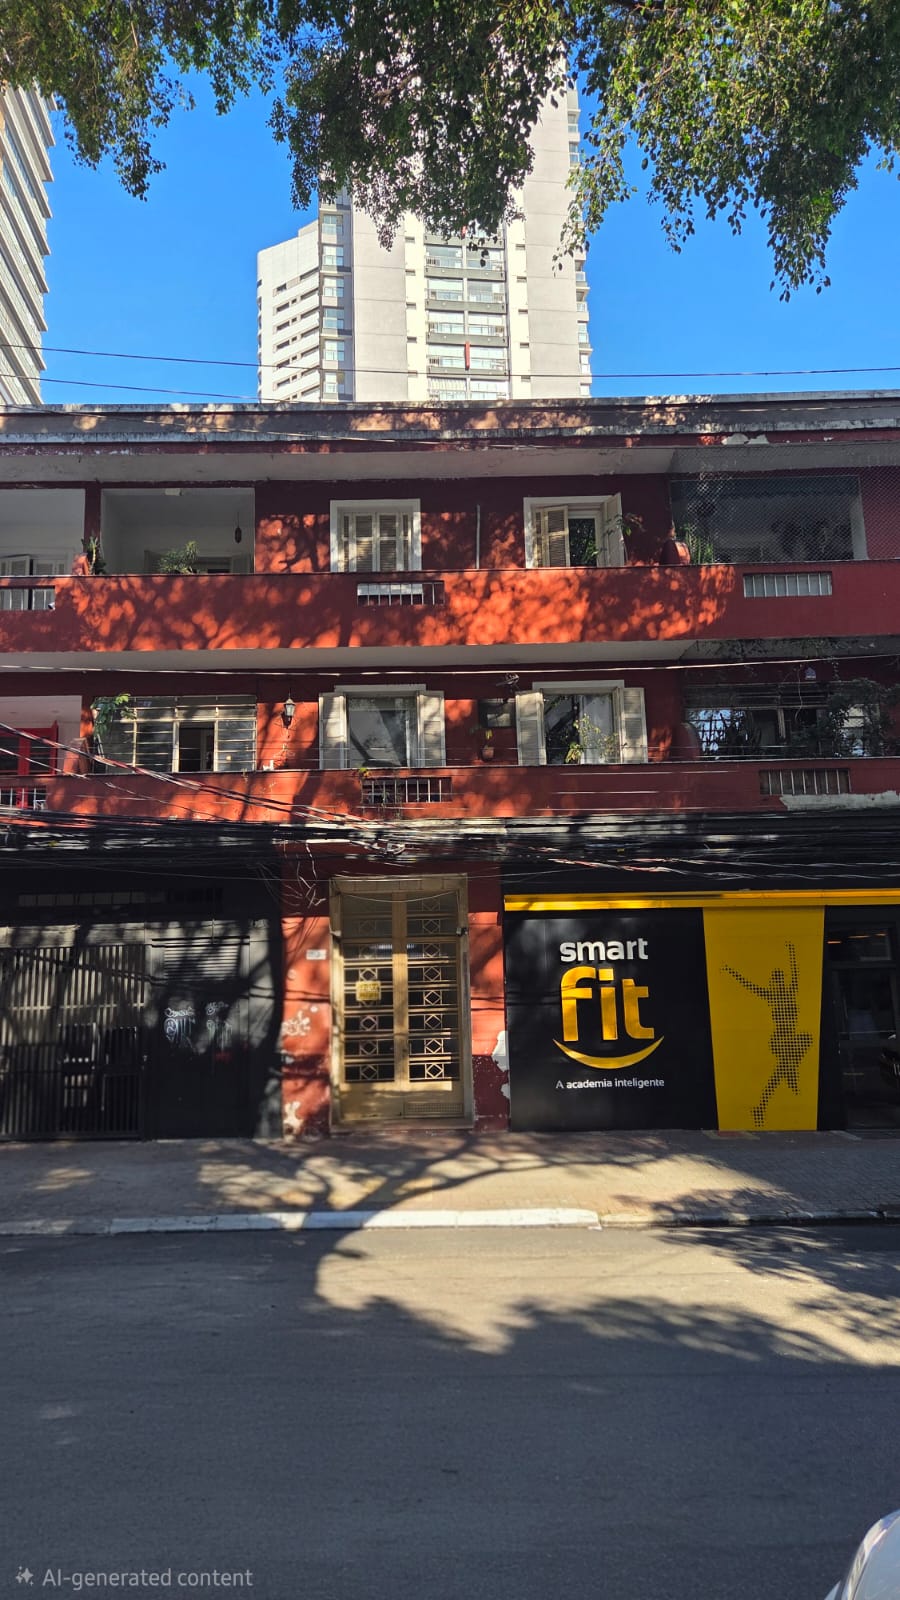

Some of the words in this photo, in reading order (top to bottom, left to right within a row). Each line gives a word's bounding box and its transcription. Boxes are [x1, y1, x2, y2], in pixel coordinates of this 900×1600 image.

[559, 937, 649, 962] smart
[560, 966, 655, 1042] fit
[555, 1079, 564, 1089] A
[566, 1077, 613, 1089] academia
[614, 1077, 665, 1090] inteligente
